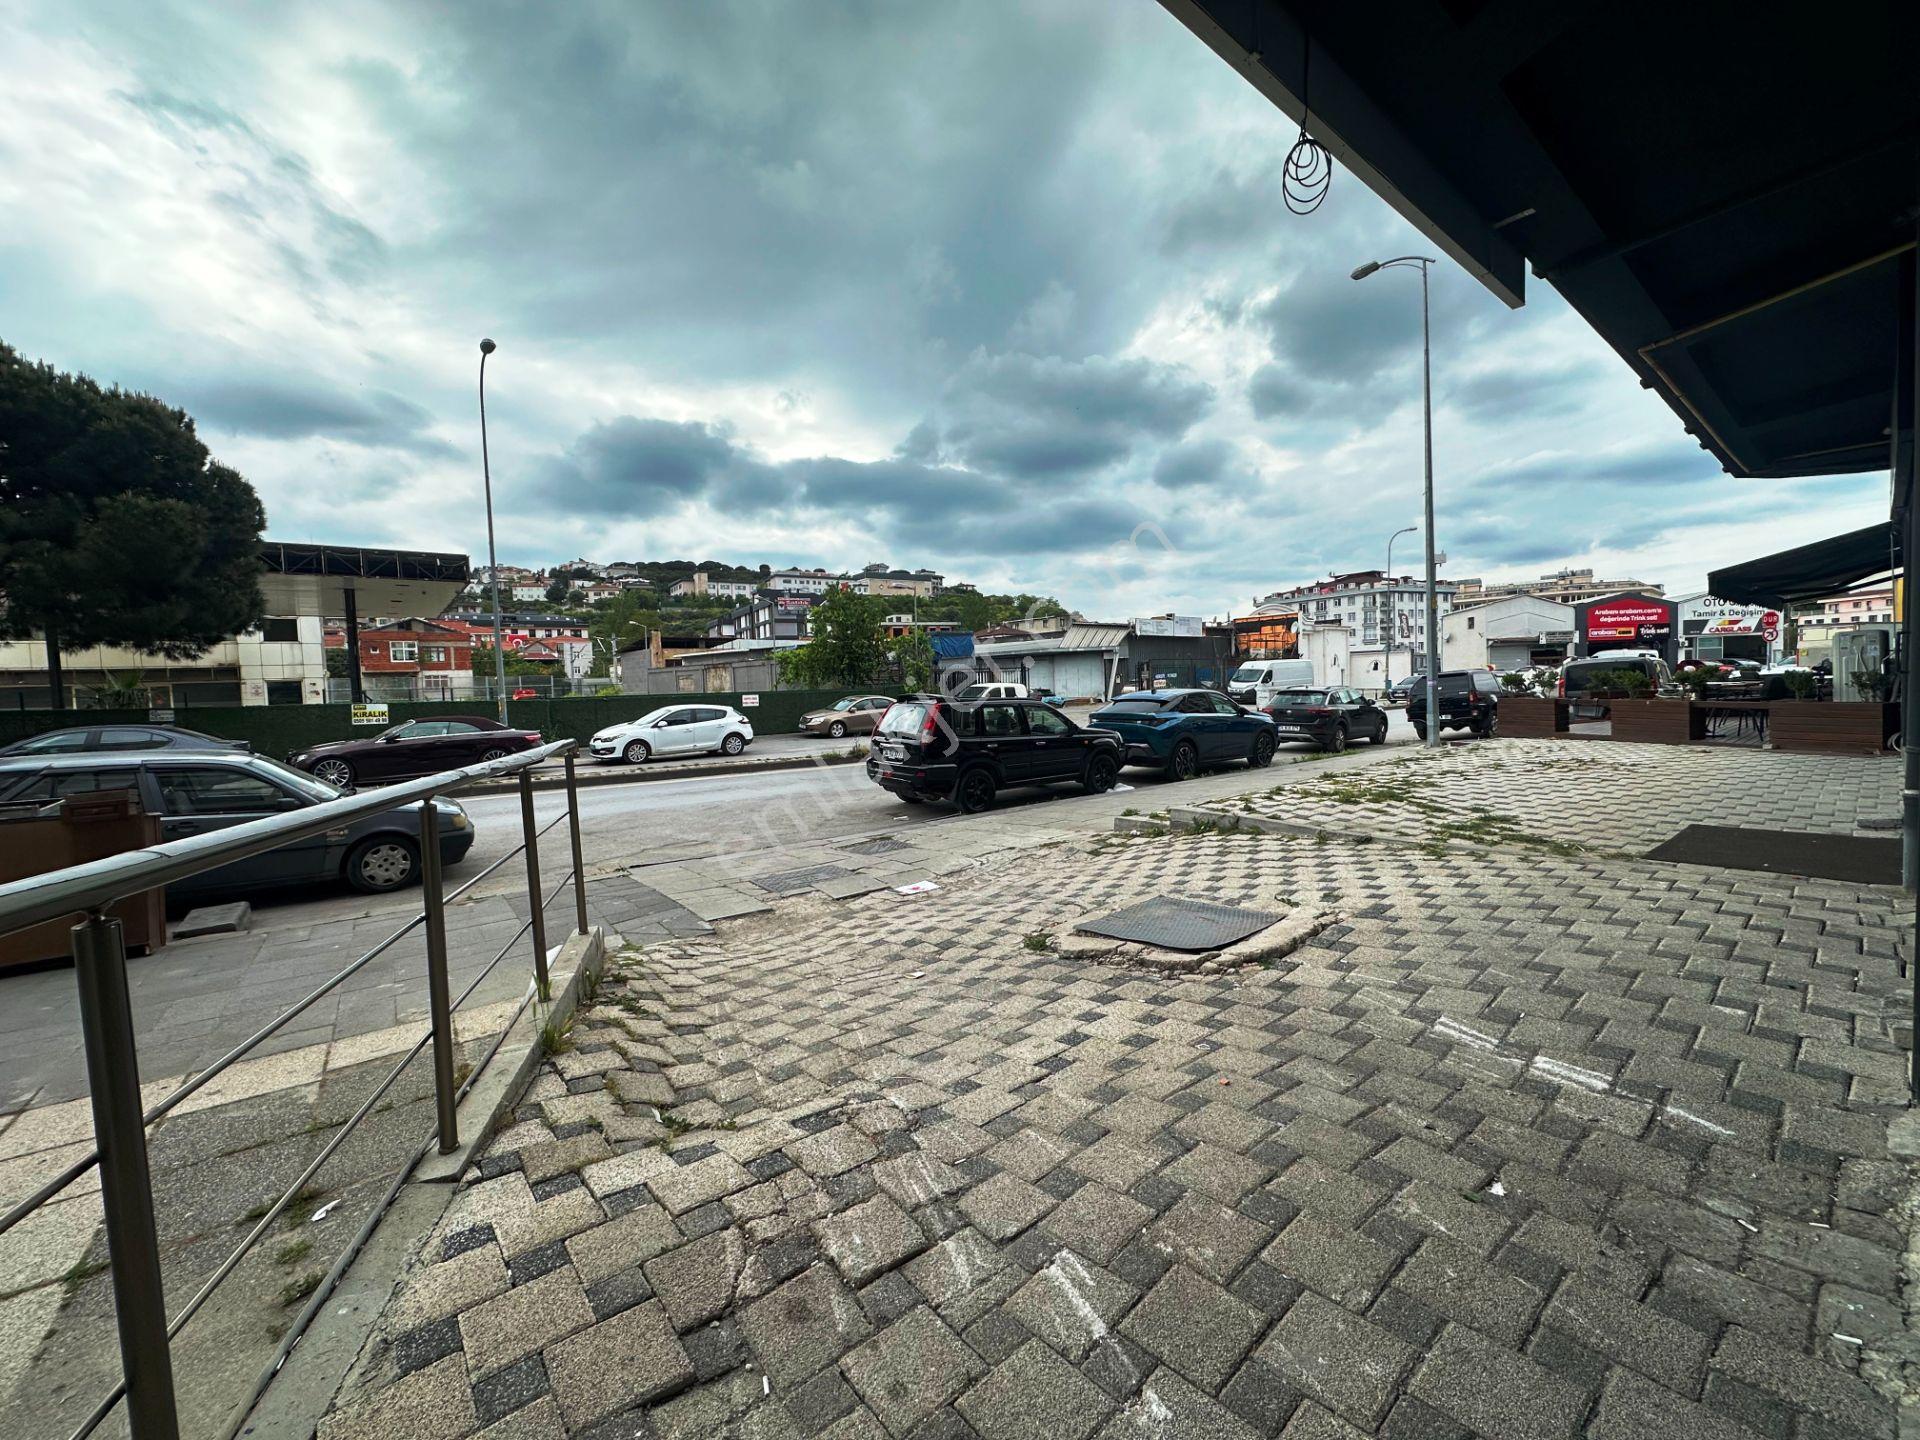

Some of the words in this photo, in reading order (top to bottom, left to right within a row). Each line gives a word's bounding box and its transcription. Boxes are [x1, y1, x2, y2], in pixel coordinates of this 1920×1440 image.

[1728, 609, 1766, 617] Değişim
[1763, 615, 1778, 623] DUR
[1640, 627, 1656, 635] Trink
